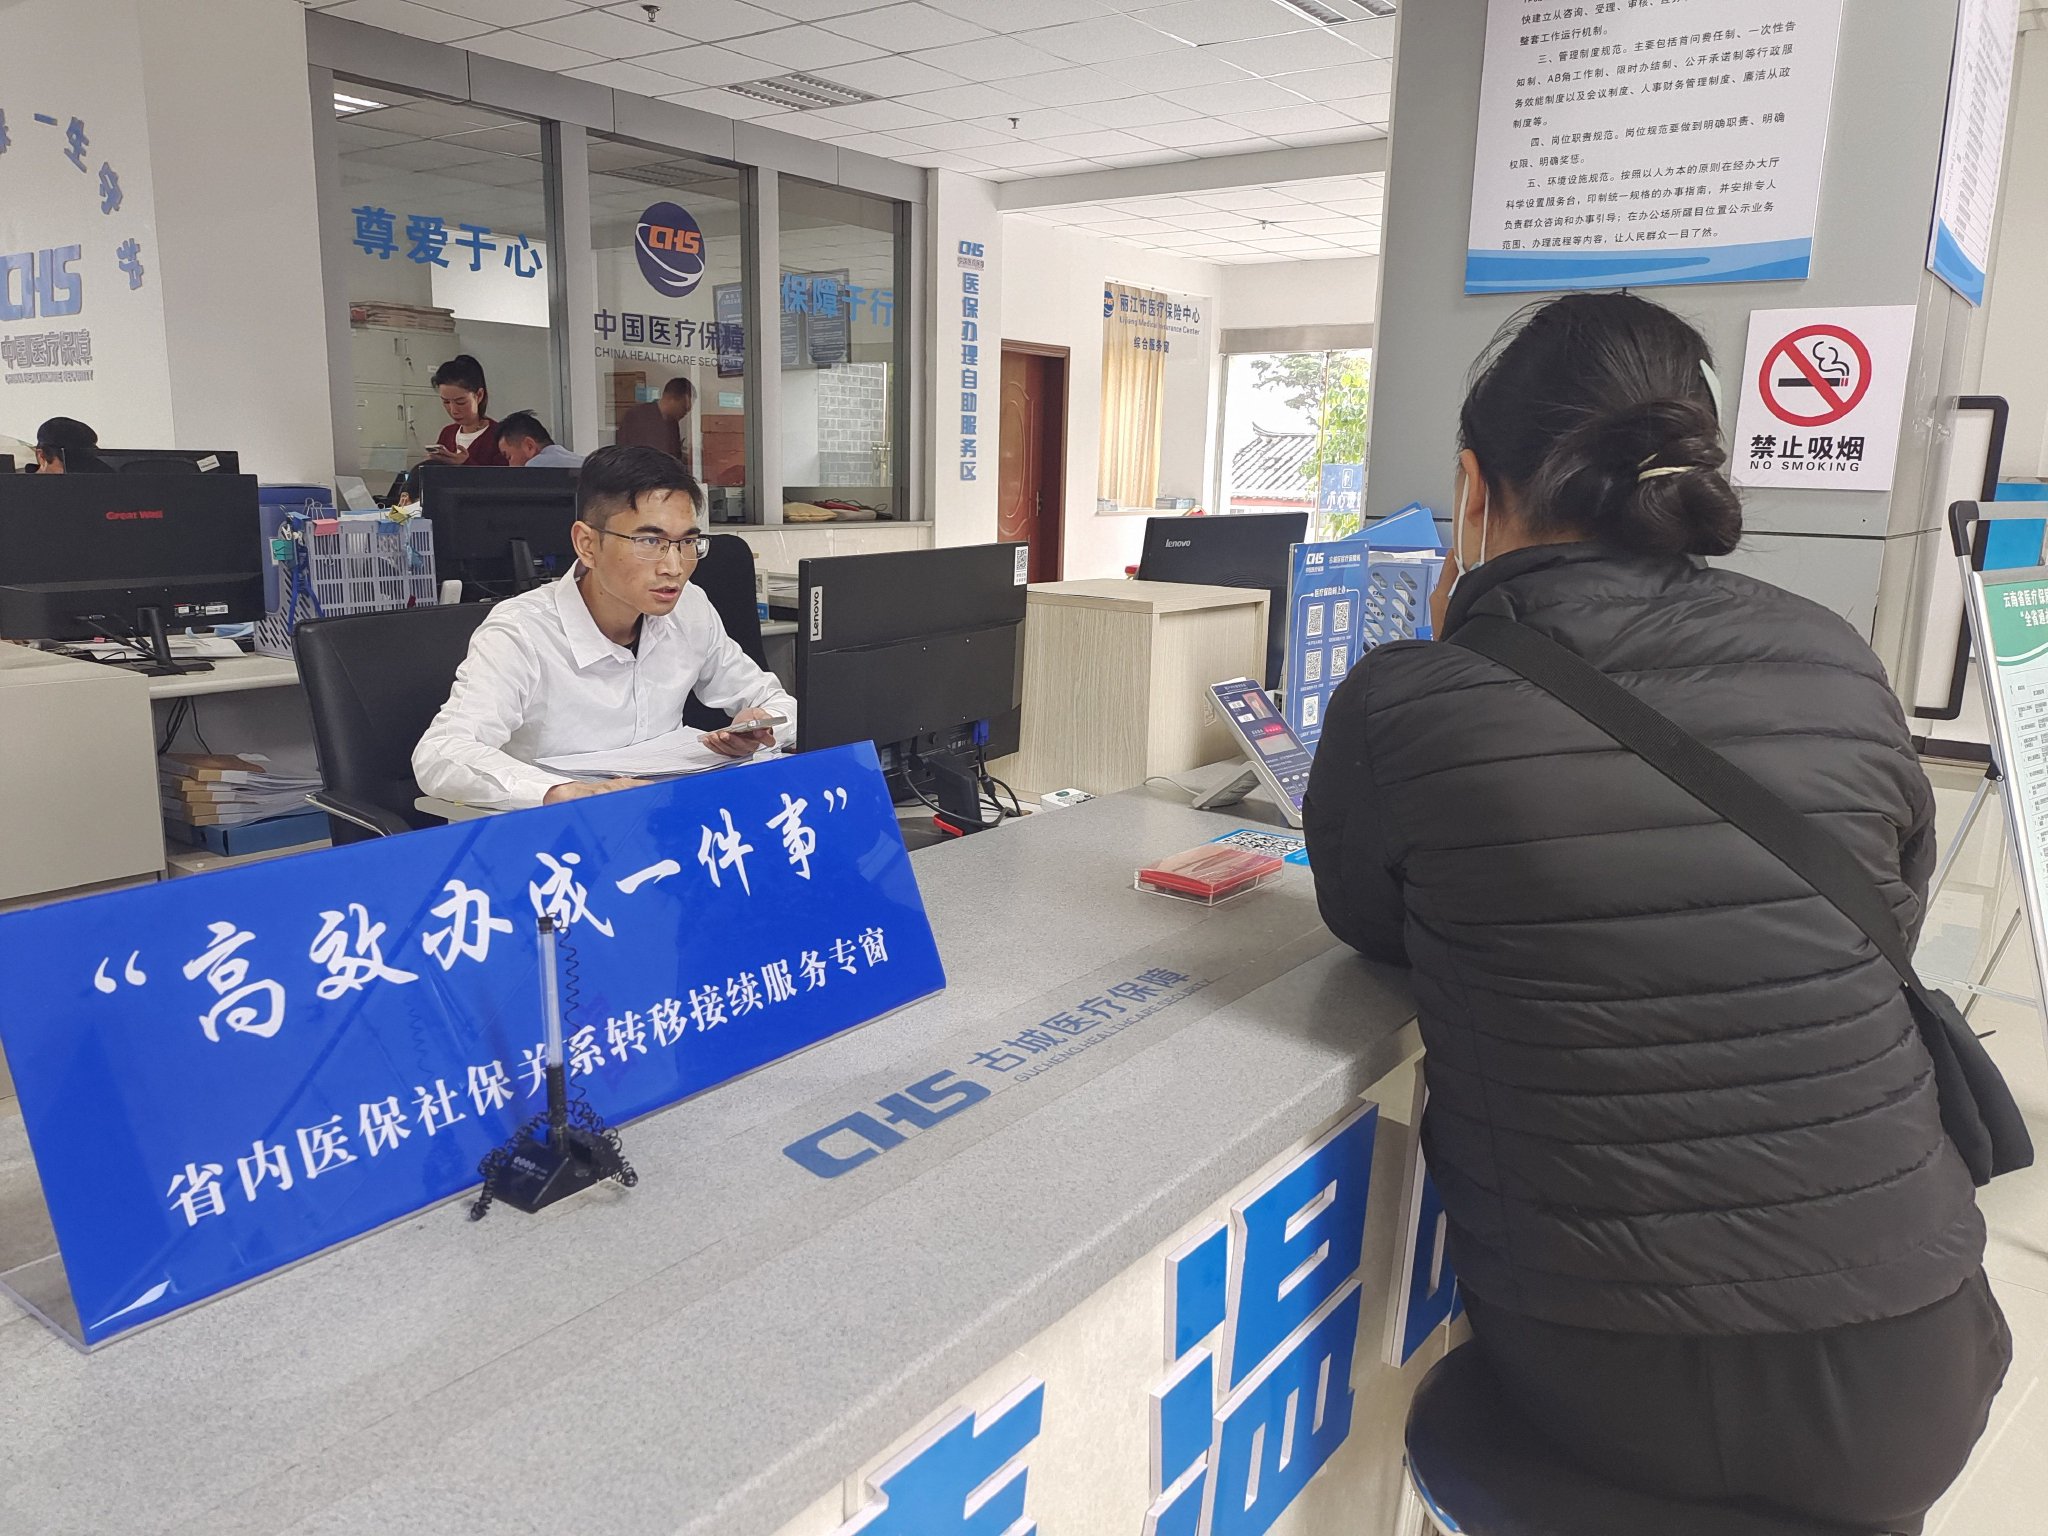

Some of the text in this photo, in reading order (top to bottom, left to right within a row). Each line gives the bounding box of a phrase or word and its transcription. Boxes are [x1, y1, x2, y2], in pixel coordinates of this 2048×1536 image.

[351, 205, 543, 279] 尊爱于心
[648, 225, 701, 255] CHS
[958, 241, 984, 258] CHS
[781, 272, 895, 327] 保障于行
[1119, 293, 1200, 324] 丽江市医疗保险中心
[594, 308, 745, 355] 中国医疗保障
[594, 346, 628, 359] CHINA
[630, 350, 697, 367] HEALTHCARE
[960, 272, 979, 481] 医保办理自助服务区
[1749, 460, 1860, 472] NO SMOKING
[1750, 434, 1865, 461] 禁止吸烟
[812, 591, 820, 637] Lenovo
[94, 786, 849, 1043] “高效办成一件事”
[966, 966, 1192, 1073] 古城医疗保障
[167, 926, 889, 1227] 省内医保社保关系转移接续服务专窗
[1013, 1047, 1083, 1083] GUCHENG
[782, 1068, 992, 1180] CHS
